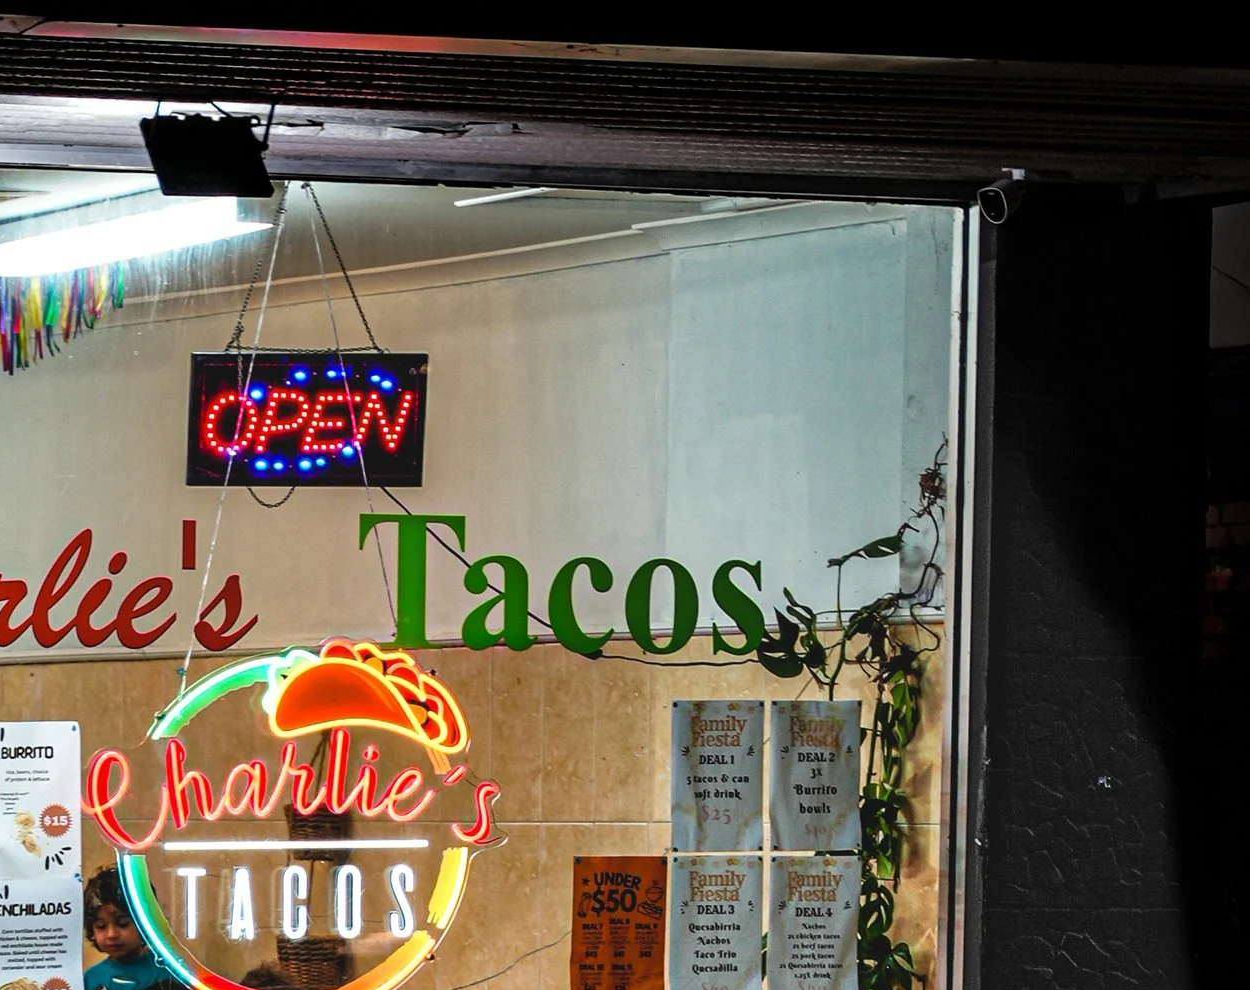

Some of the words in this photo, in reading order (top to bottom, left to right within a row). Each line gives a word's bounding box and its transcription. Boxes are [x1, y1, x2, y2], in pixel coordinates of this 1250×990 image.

[204, 388, 415, 453] OPEN
[358, 513, 767, 656] Tacos
[691, 715, 747, 732] Family
[691, 732, 741, 748] Fiesta
[1, 746, 53, 760] BURRITO
[699, 754, 728, 765] DEAL
[730, 754, 734, 765] 1
[798, 752, 826, 763] DEAL
[829, 752, 835, 763] 2
[687, 776, 691, 785] 5
[694, 775, 717, 783] tacos
[721, 774, 728, 783] &
[82, 728, 500, 849] Charlie's
[714, 788, 742, 800] drink
[793, 784, 837, 796] Burrito
[701, 804, 731, 825] $25
[799, 802, 831, 814] bowls
[43, 815, 68, 826] $15
[594, 872, 641, 890] UNDER
[689, 870, 746, 888] Family
[788, 870, 843, 888] Family
[690, 886, 740, 902] Fiesta
[788, 886, 837, 902] Fiesta
[177, 863, 415, 941] TACOS
[591, 887, 637, 917] $50
[697, 904, 727, 915] DEAL
[729, 904, 735, 915] 3
[795, 907, 824, 917] DEAL
[826, 907, 833, 917] 4
[689, 922, 740, 932] Quesabirria
[697, 936, 730, 946] Nachos
[694, 950, 715, 959] Taco
[718, 950, 736, 959] Trio
[692, 963, 737, 973] Quesadilla
